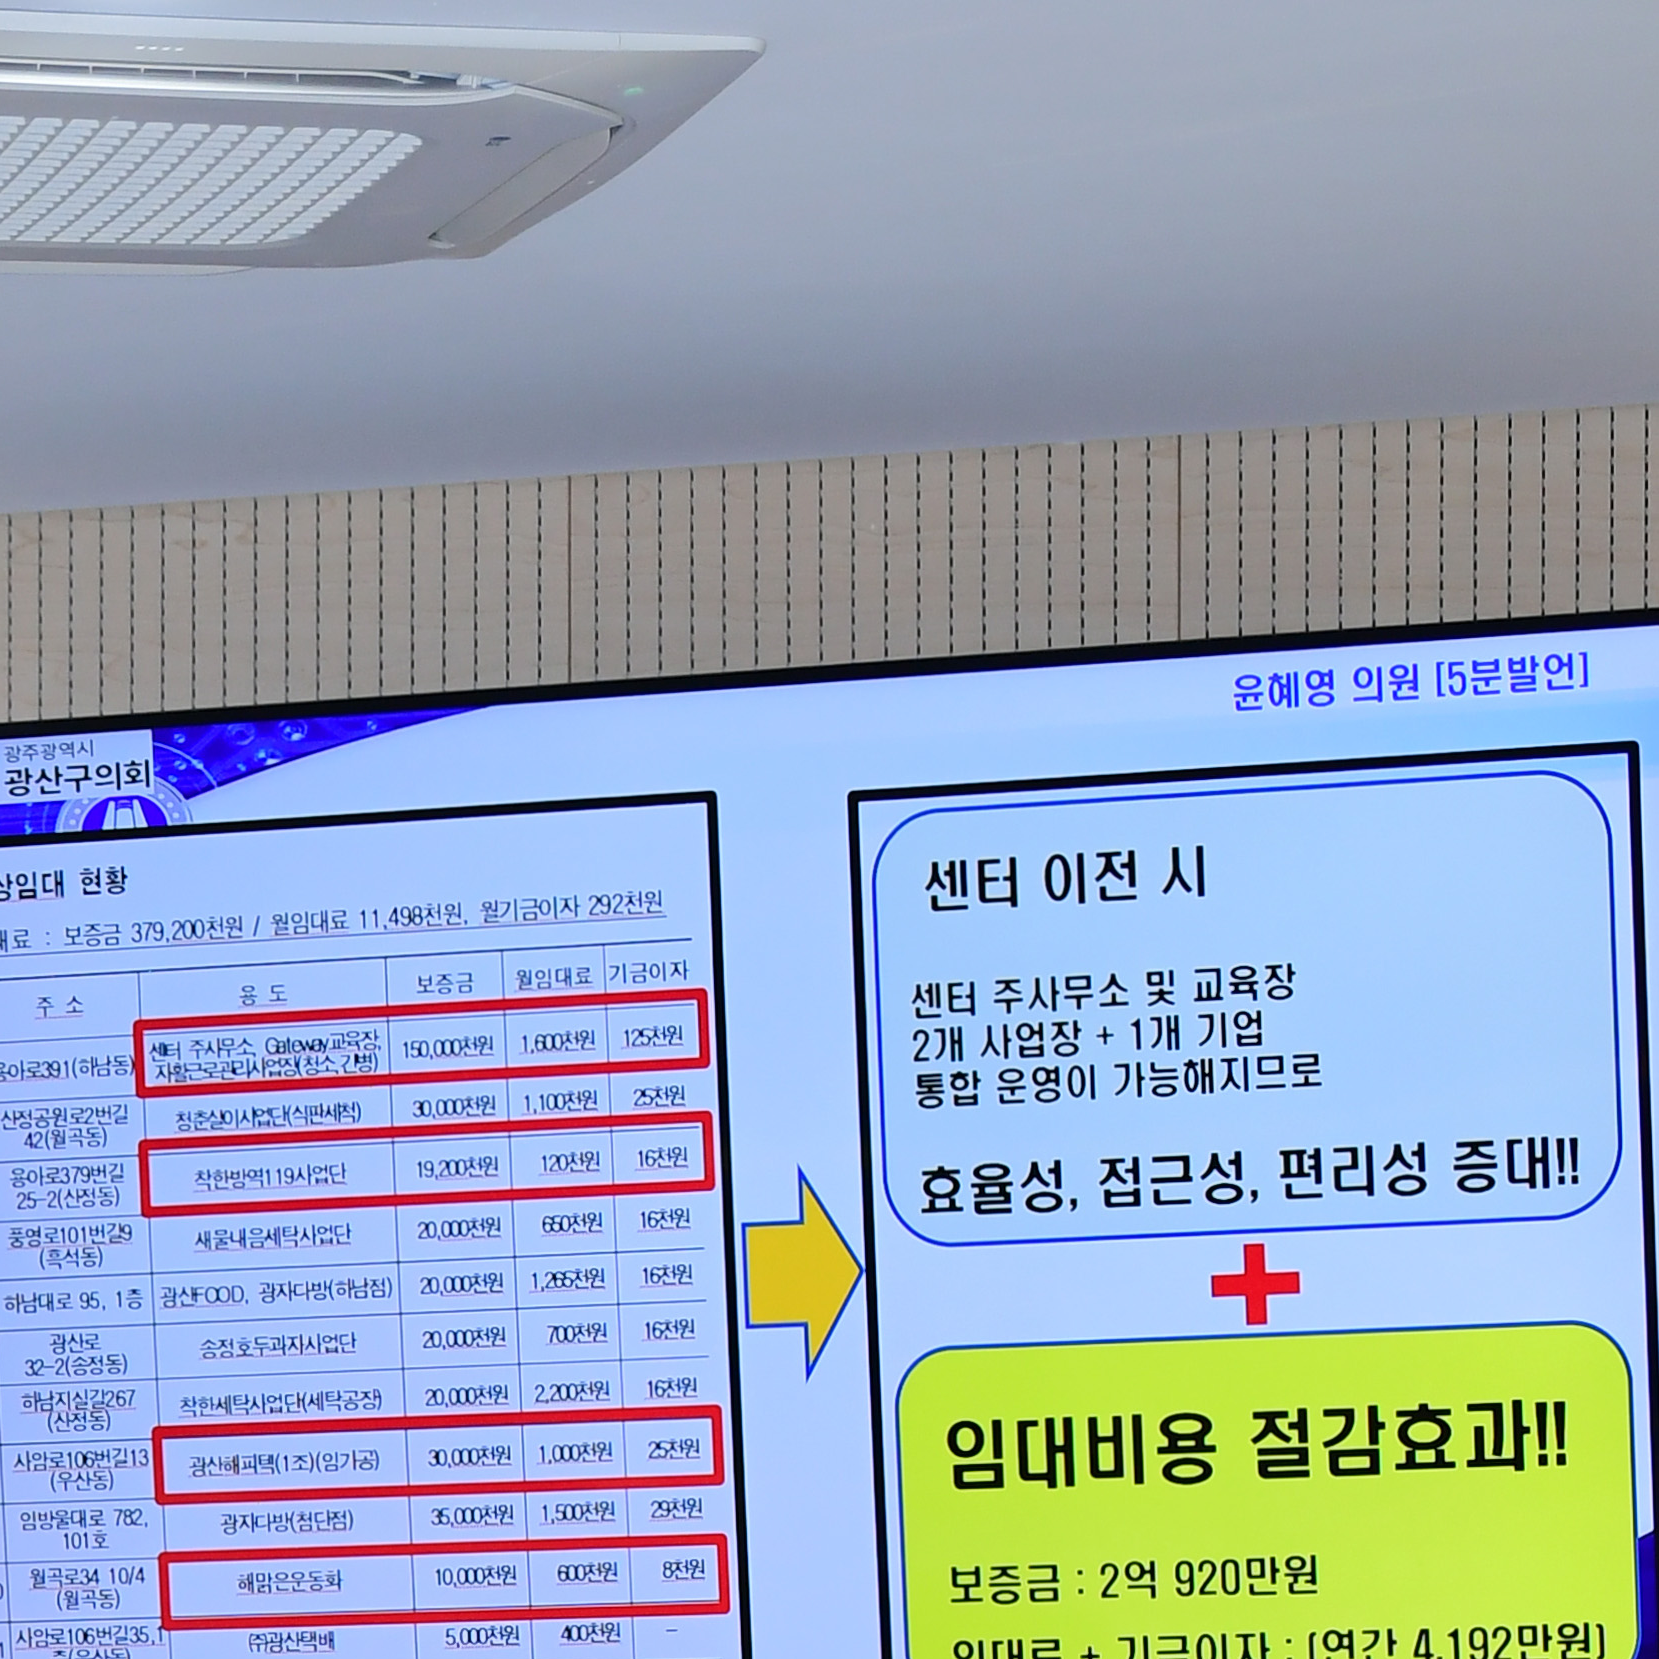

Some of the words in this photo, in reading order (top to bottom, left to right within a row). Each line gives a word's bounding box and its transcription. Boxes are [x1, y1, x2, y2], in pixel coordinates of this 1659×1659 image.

[1232, 668, 1336, 712] 윤혜영
[1352, 662, 1421, 705] 의원
[1435, 651, 1590, 702] [5분발언]
[4, 739, 95, 763] 광주광역시
[4, 759, 151, 797] 광산구의회
[79, 866, 128, 896] 현황
[925, 856, 1020, 913] 센터
[1044, 849, 1139, 906] 이전
[1162, 845, 1208, 898] 시
[65, 923, 122, 947] 보증금
[131, 916, 243, 945] 379,200천원
[271, 909, 348, 935] 월임대료
[359, 901, 468, 931] 11,498천원,
[480, 895, 580, 924] 월기금이자
[588, 890, 663, 917] 292천원
[417, 972, 474, 994] 보증금
[515, 966, 593, 990] 월임대료
[608, 959, 689, 985] 기금이자
[911, 981, 977, 1019] 센터
[993, 971, 1129, 1014] 주사무소
[1146, 969, 1175, 1006] 및
[1194, 963, 1296, 1002] 교육장
[149, 1041, 181, 1062] 센터
[403, 1035, 494, 1059] 150,000천원
[520, 1030, 595, 1054] 1,600천원
[623, 1024, 683, 1048] 125천원
[912, 1025, 963, 1064] 2개
[980, 1020, 1082, 1059] 사업장
[1131, 1014, 1180, 1052] 1개
[1197, 1010, 1263, 1048] 기업
[915, 1070, 980, 1109] 통합
[996, 1064, 1097, 1106] 운영이
[1114, 1052, 1322, 1099] 가능해지므로
[412, 1095, 496, 1118] 30,000천원
[524, 1089, 598, 1113] 1,100천원
[633, 1084, 685, 1106] 25천원
[1, 1104, 129, 1131] 산정공원로2번길
[23, 1126, 107, 1151] 42(월곡동)
[10, 1163, 125, 1188] 용아로379번길
[194, 1163, 347, 1190] 착한방역119사업단
[416, 1156, 499, 1180] 19,200천원
[541, 1151, 600, 1174] 120천원
[637, 1147, 688, 1169] 16천원
[921, 1160, 1079, 1215] 효율성,
[1100, 1150, 1259, 1209] 접근성,
[1280, 1142, 1428, 1199] 편리성
[1452, 1136, 1580, 1191] 증대!!
[16, 1186, 120, 1211] 25-2(산정동)
[8, 1224, 132, 1250] 풍영로101번길9
[195, 1224, 352, 1250] 새물내음세탁사업단
[418, 1216, 501, 1240] 20,000천원
[542, 1212, 603, 1235] 650천원
[640, 1208, 691, 1230] 16천원
[40, 1246, 103, 1270] (흑석동)
[259, 1276, 393, 1304] 광자다방(하남점)
[420, 1273, 503, 1296] 20,000천원
[530, 1268, 605, 1292] 1,265천원
[642, 1264, 693, 1287] 16천원
[4, 1291, 73, 1314] 하남대로
[79, 1291, 106, 1311] 95,
[116, 1288, 143, 1310] 1층
[50, 1333, 101, 1354] 광산로
[199, 1332, 357, 1360] 송정호두과자사업단
[422, 1327, 506, 1351] 20,000천원
[547, 1322, 607, 1345] 700천원
[645, 1319, 695, 1341] 16천원
[24, 1353, 128, 1378] 32-2(송정동)
[21, 1389, 136, 1413] 하남지실길267
[180, 1388, 382, 1418] 착한세탁사업단(세탁공장)
[425, 1384, 509, 1407] 20,000천원
[535, 1380, 609, 1404] 2,200천원
[647, 1377, 698, 1399] 16천원
[47, 1409, 111, 1433] (산정동)
[428, 1445, 512, 1468] 30,000천원
[539, 1441, 613, 1466] 1,000천원
[648, 1438, 700, 1460] 25천원
[946, 1411, 1217, 1490] 임대비용
[1250, 1400, 1568, 1481] 절감효과!!
[14, 1448, 150, 1473] 사암로106번길13
[50, 1469, 114, 1493] (우산동)
[20, 1508, 106, 1532] 임방울대로
[114, 1508, 148, 1529] 782,
[220, 1508, 354, 1536] 광자다방(첨단점)
[431, 1505, 514, 1527] 35,000천원
[541, 1501, 615, 1525] 1,500천원
[650, 1498, 703, 1520] 29천원
[63, 1530, 109, 1551] 101호
[30, 1567, 100, 1591] 월곡로34
[237, 1568, 344, 1595] 해맑은운동화
[435, 1565, 517, 1588] 10,000천원
[557, 1562, 618, 1584] 600천원
[662, 1559, 705, 1581] 8천원
[950, 1564, 1061, 1605] 보증금
[1100, 1559, 1158, 1600] 2억
[1175, 1554, 1319, 1598] 920만원
[56, 1588, 121, 1611] (월곡동)
[445, 1625, 521, 1649] 5,000천원
[560, 1622, 621, 1645] 400천원
